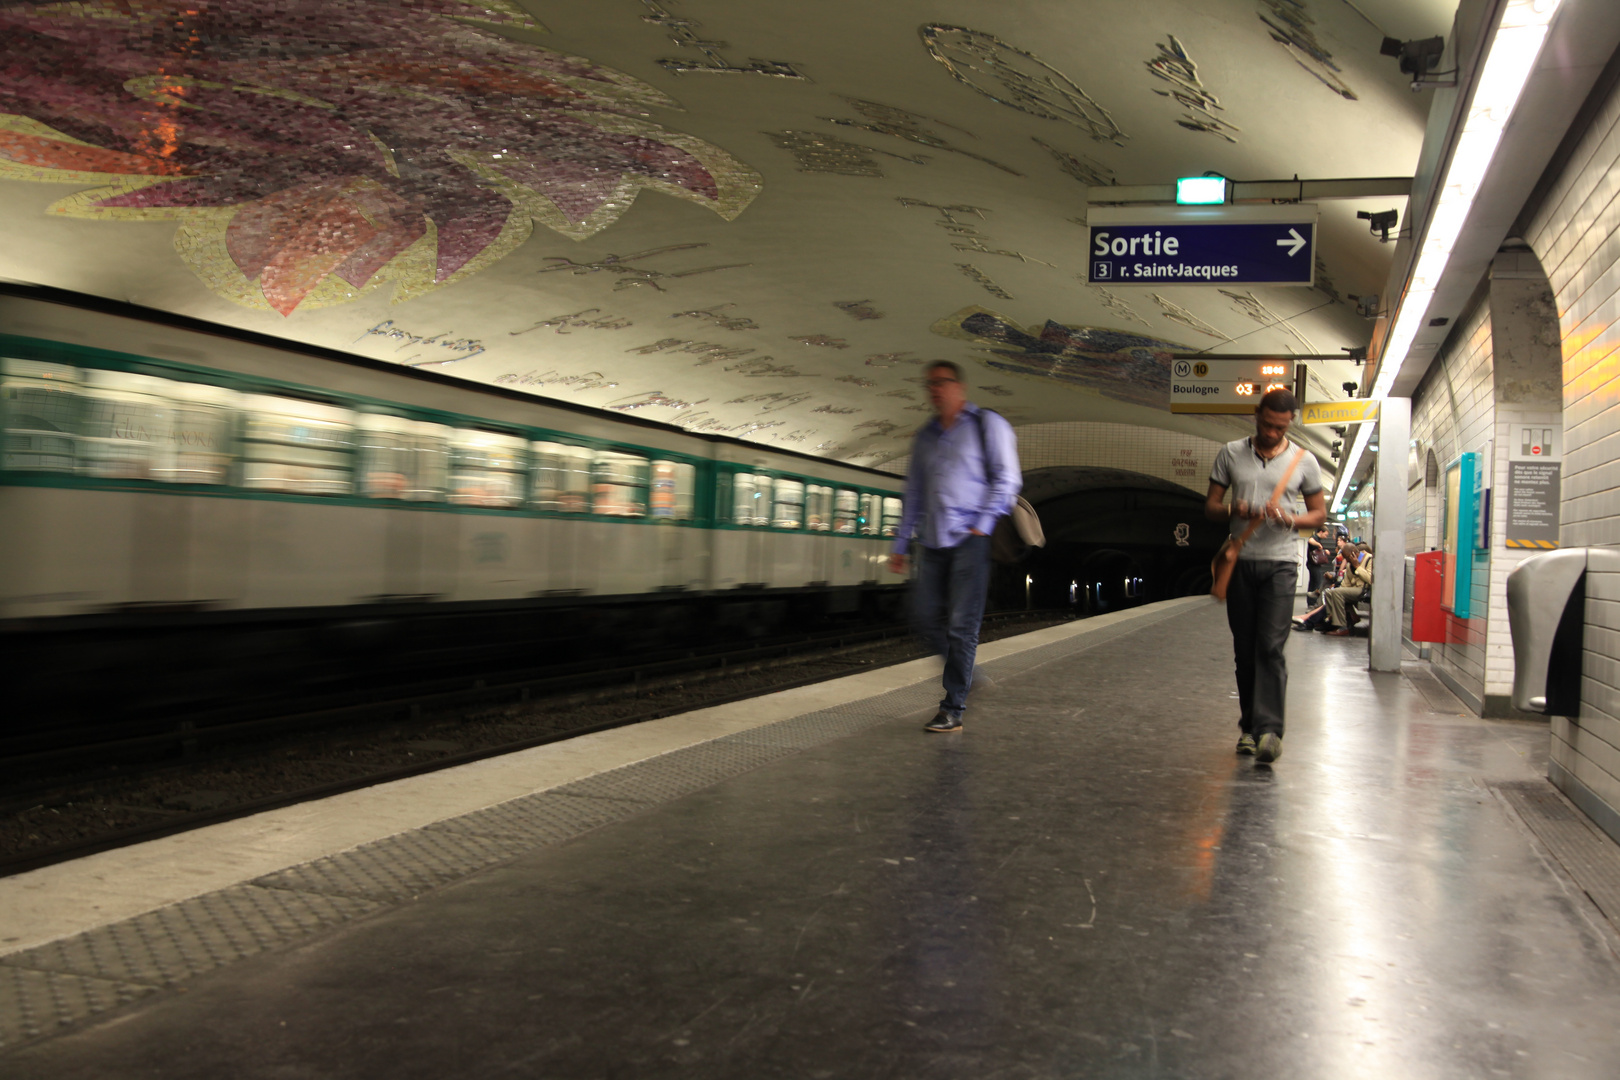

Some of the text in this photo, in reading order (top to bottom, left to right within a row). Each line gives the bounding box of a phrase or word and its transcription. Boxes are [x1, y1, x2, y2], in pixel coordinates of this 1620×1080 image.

[1094, 231, 1179, 256] Sortie
[1098, 263, 1238, 280] 3 r. Saint-Jacques
[1194, 365, 1207, 375] 10
[1173, 384, 1220, 395] Boulogne
[1236, 383, 1253, 396] 03
[1307, 407, 1359, 420] Alarme
